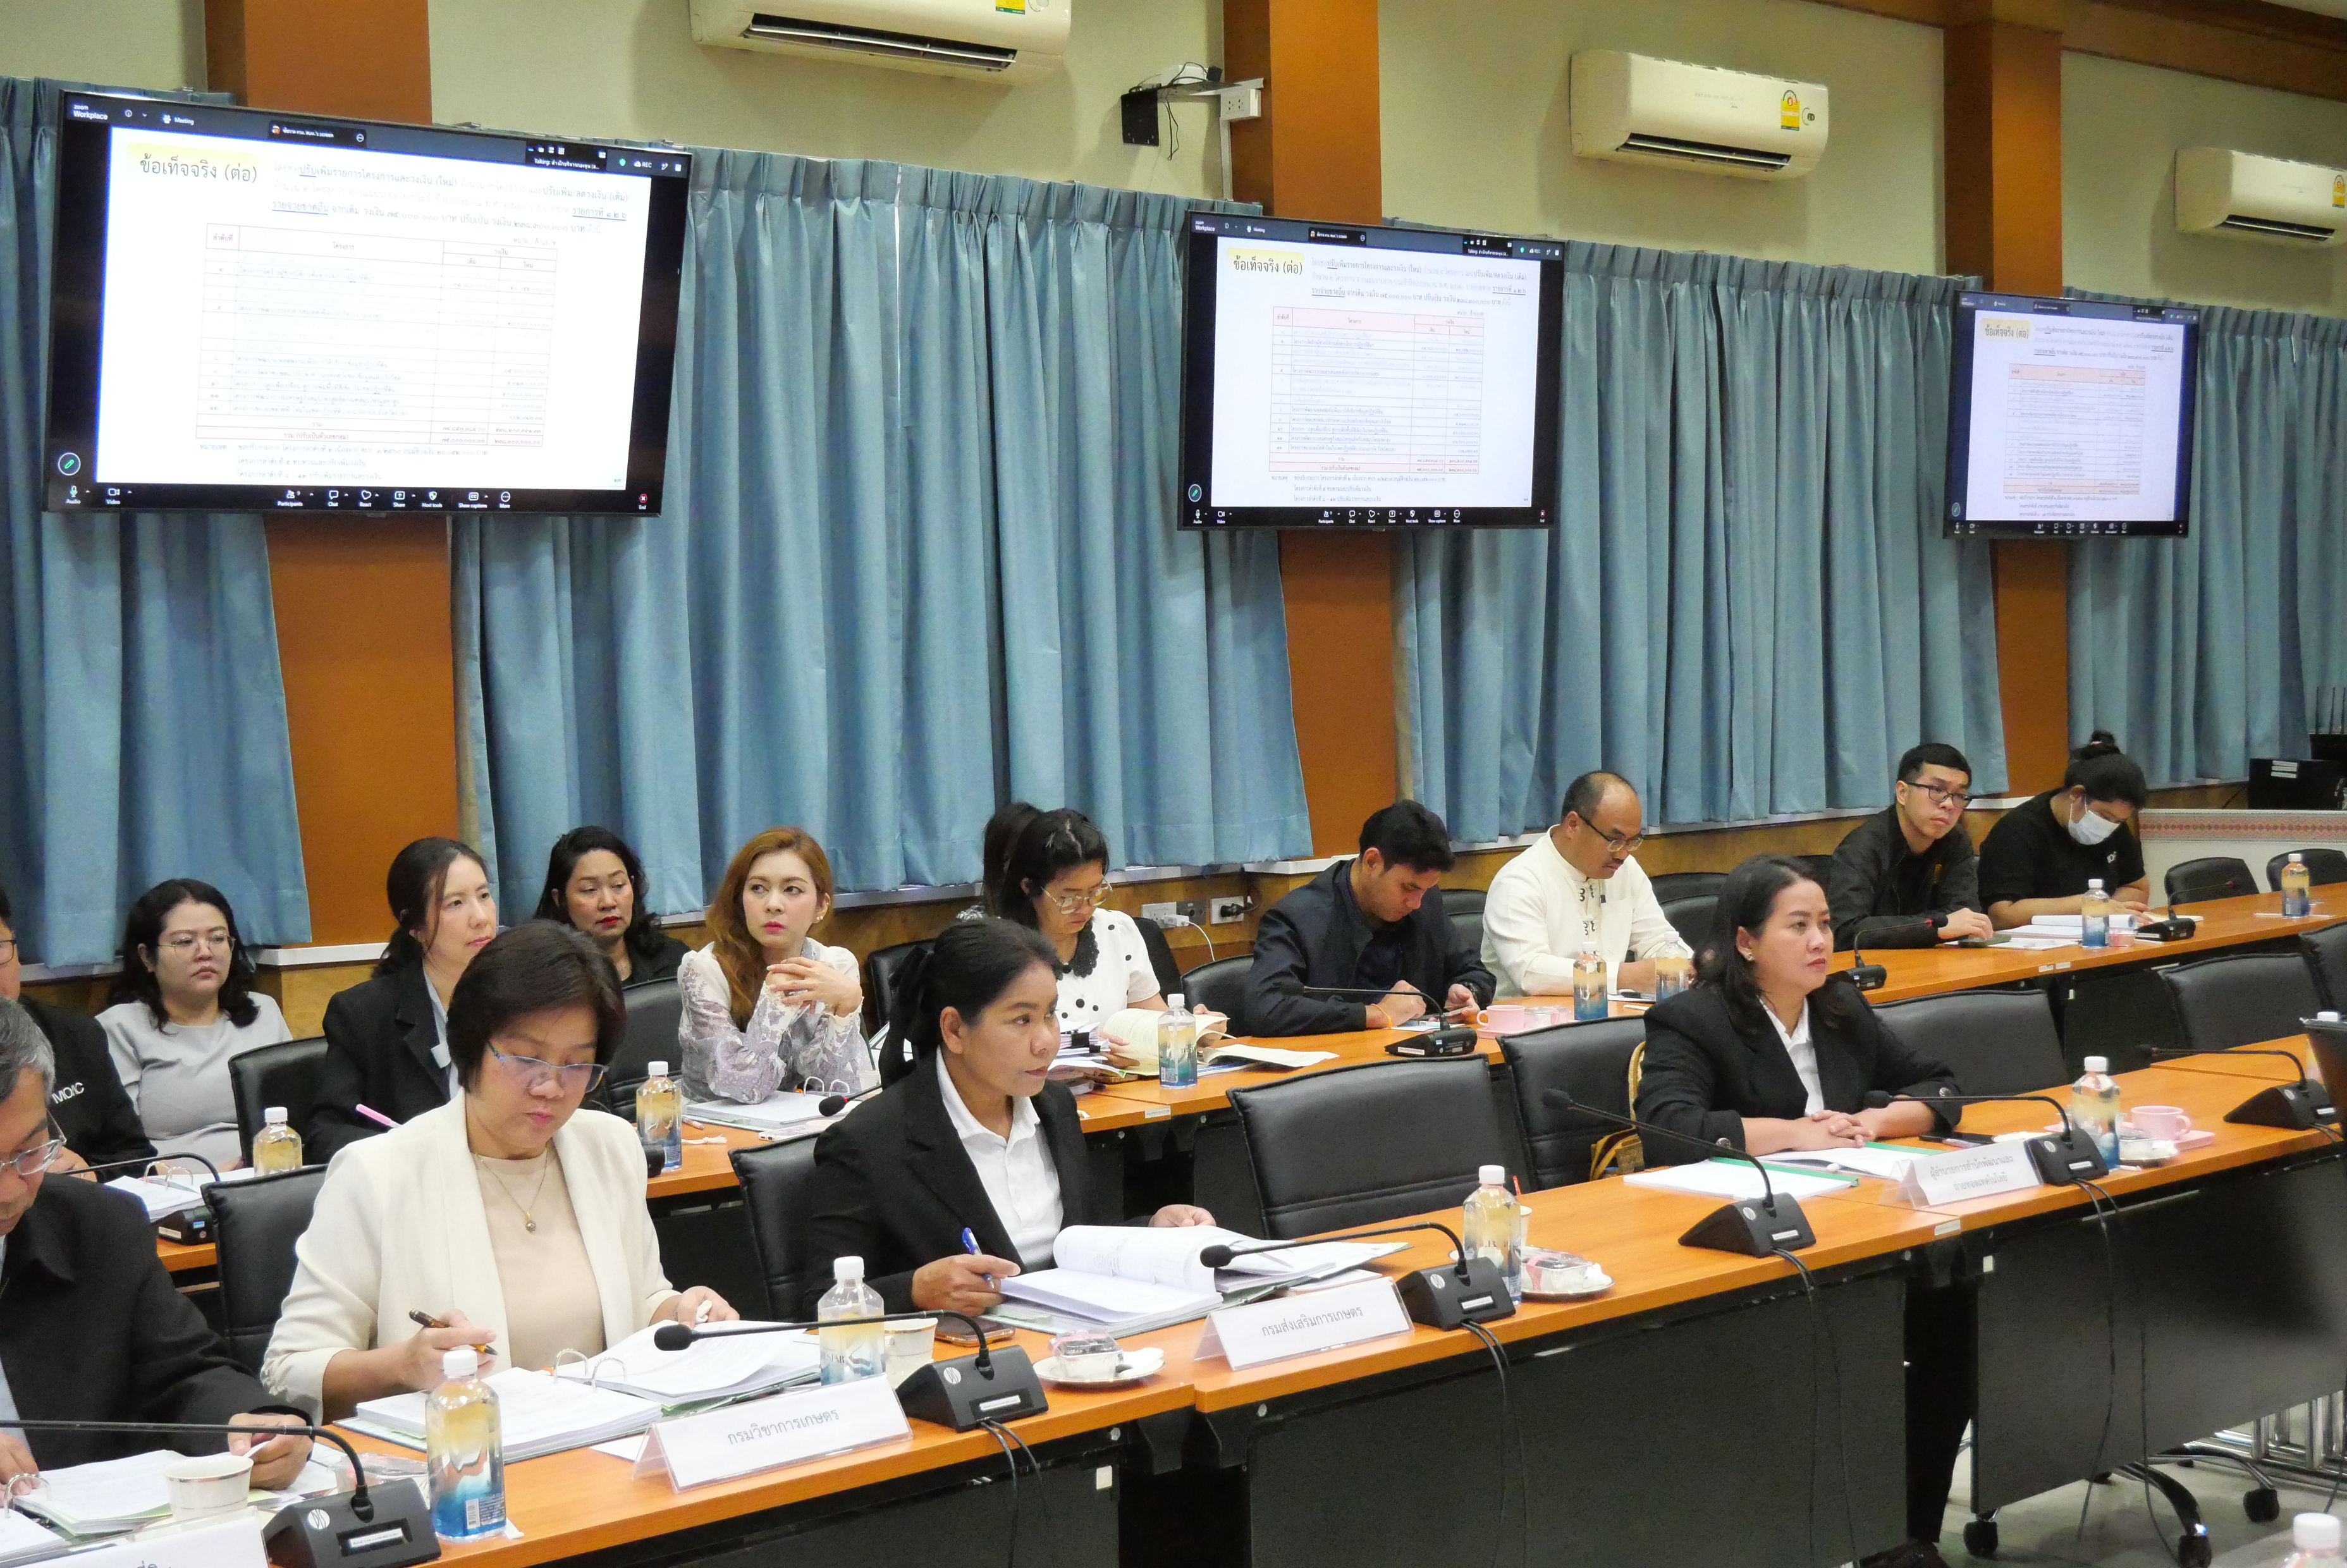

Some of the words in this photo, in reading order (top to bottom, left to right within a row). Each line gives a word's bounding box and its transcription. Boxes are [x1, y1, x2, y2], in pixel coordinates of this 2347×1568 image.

[73, 111, 108, 120] Workplace
[175, 117, 194, 126] Meeting
[140, 153, 218, 180] ข้อเท็จจริง
[224, 164, 258, 183] (ต่อ)
[436, 176, 457, 187] (ใหม่)
[610, 192, 628, 202] (เดิม)
[332, 205, 359, 216] จากเดิม
[364, 206, 385, 217] วงเงิน
[441, 213, 457, 223] บาท
[460, 214, 489, 224] ปรับเป็น
[492, 216, 512, 226] วงเงิน
[571, 224, 585, 233] บาท
[333, 242, 355, 251] โครงการ
[1233, 255, 1279, 273] ข้อเท็จจริง
[1283, 260, 1303, 275] (ต่อ)
[1408, 264, 1422, 274] (ใหม่)
[1514, 273, 1527, 281] (เดิม)
[1347, 288, 1364, 297] จากเดิม
[1366, 290, 1379, 298] วงเงิน
[1412, 293, 1423, 302] บาท
[1424, 293, 1442, 303] ปรับเป็น
[1443, 294, 1456, 303] วงเงิน
[1985, 324, 2014, 337] ข้อเท็จจริง
[2016, 329, 2029, 339] (ต่อ)
[476, 448, 488, 456] บาท
[52, 1082, 85, 1105] MOAC
[1930, 1155, 2014, 1181] ผู้อำนวยการสำนักพัฒนาและ
[1953, 1172, 2008, 1191] ถ่ายทอดเทคโนโลยี
[1261, 1305, 1364, 1337] กรมส่งเสริมการเกษตร
[728, 1407, 840, 1445] กรมวิชาการเกษตร
